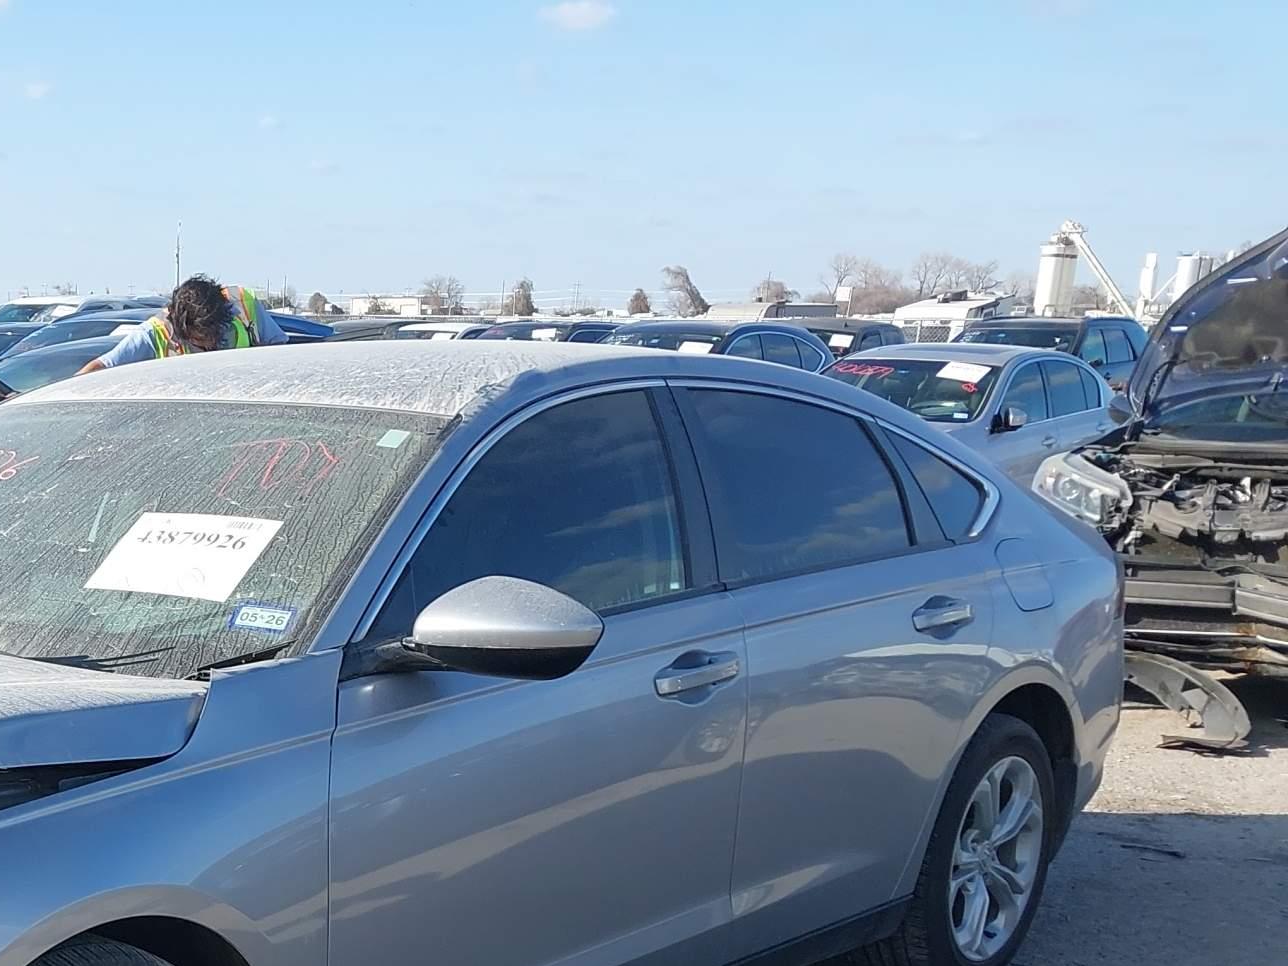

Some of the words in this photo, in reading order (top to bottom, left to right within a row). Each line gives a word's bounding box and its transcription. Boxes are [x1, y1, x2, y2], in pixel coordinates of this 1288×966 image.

[136, 530, 249, 551] 43879926
[239, 611, 258, 623] 05
[265, 614, 286, 626] 26
